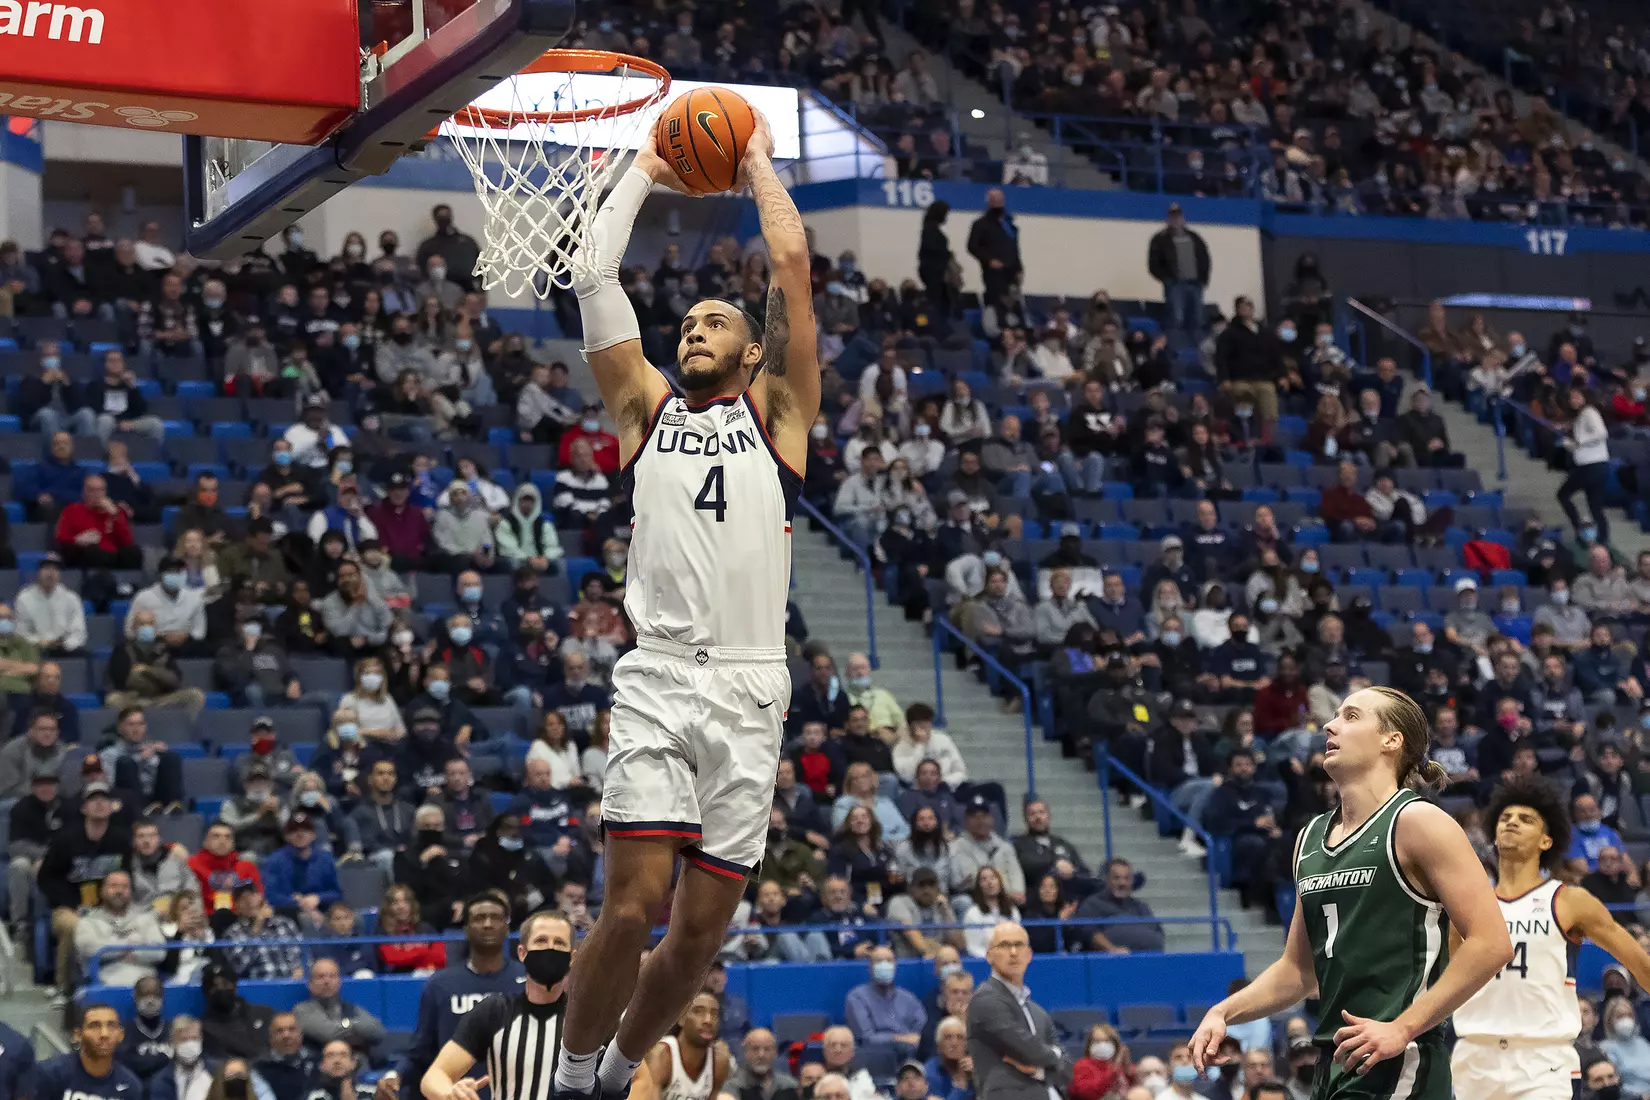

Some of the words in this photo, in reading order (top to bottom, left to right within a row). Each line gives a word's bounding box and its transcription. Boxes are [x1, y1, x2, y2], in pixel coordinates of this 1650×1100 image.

[0, 0, 105, 44] arm
[669, 117, 694, 174] ELITE
[882, 180, 935, 207] 116
[1524, 229, 1568, 255] 117
[657, 427, 757, 456] UCONN
[694, 466, 727, 522] 4
[1322, 903, 1338, 958] 1
